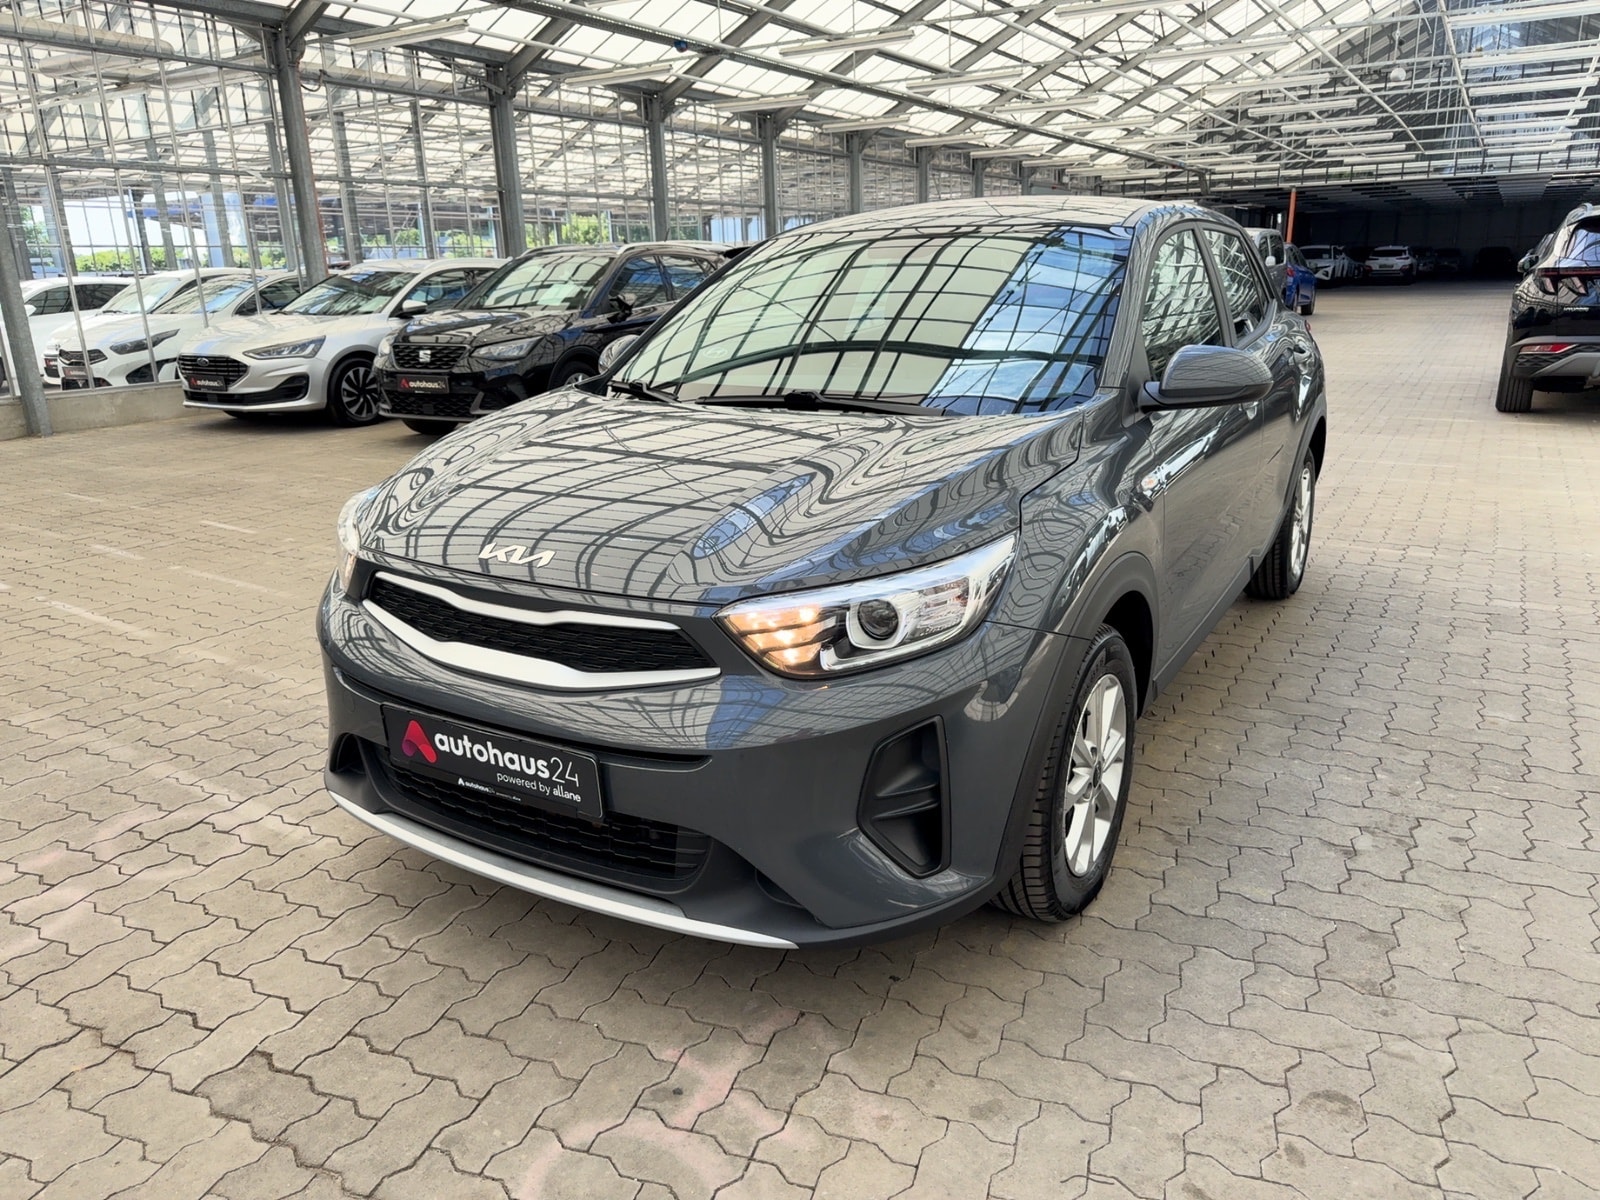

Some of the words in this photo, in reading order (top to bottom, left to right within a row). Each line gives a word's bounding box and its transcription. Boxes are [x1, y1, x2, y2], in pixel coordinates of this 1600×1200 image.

[478, 542, 556, 568] KIA
[434, 732, 580, 787] autohaus24
[496, 772, 538, 790] powered
[539, 781, 551, 796] by
[552, 785, 582, 803] allane
